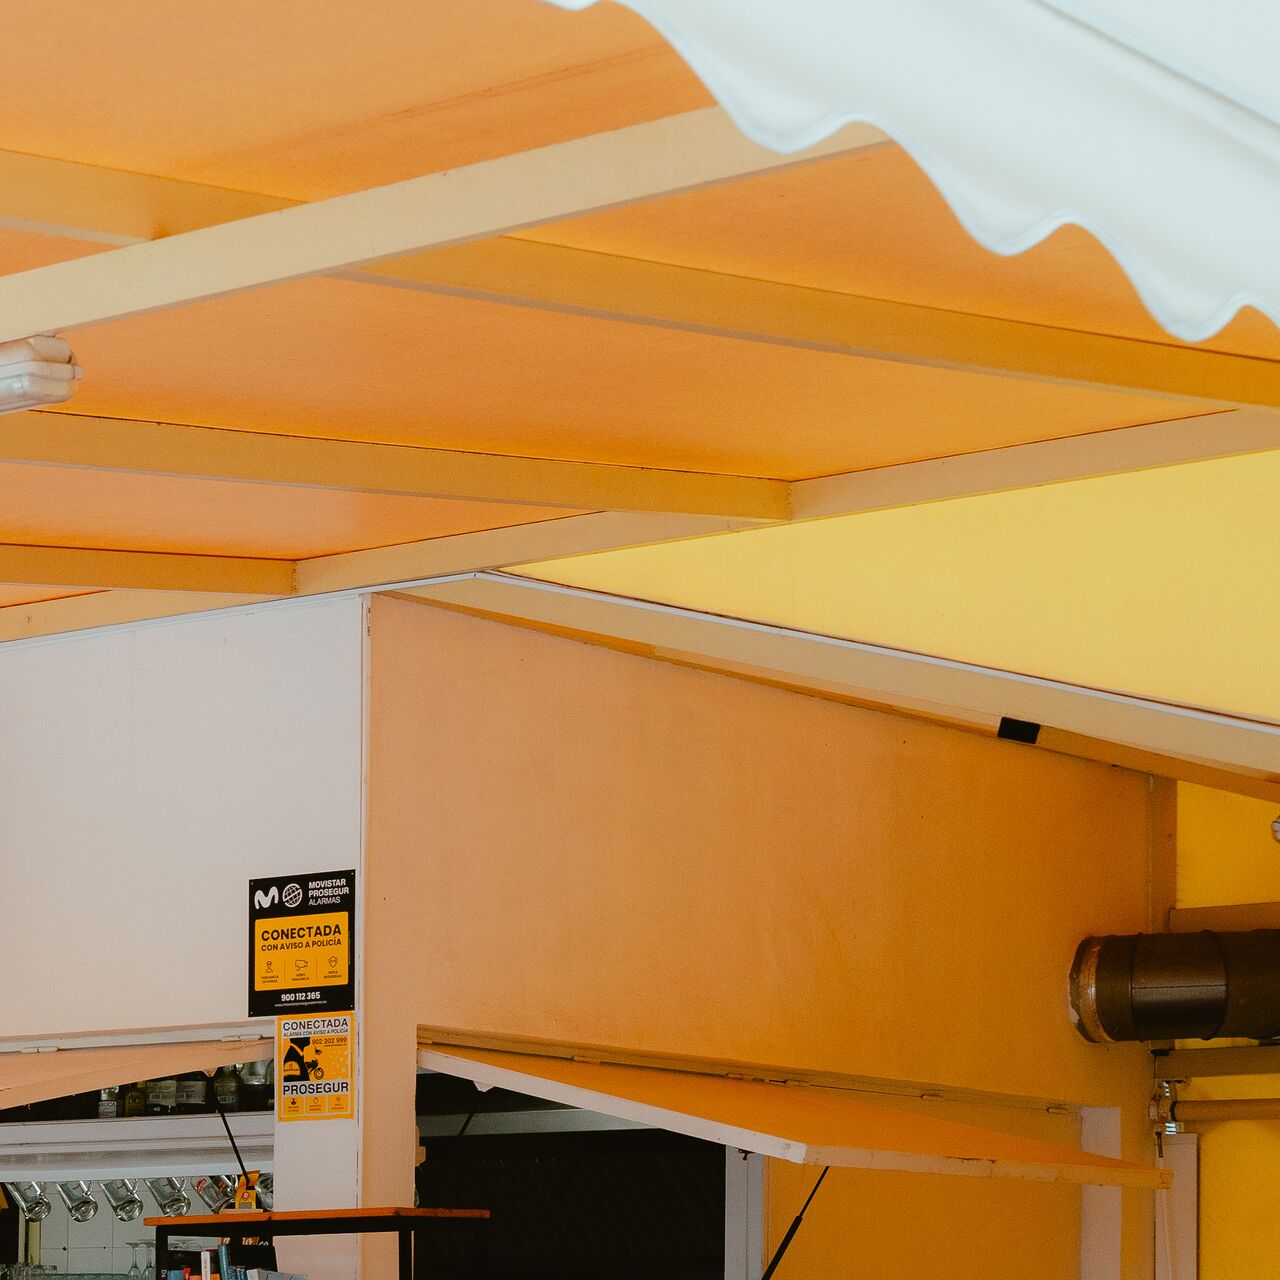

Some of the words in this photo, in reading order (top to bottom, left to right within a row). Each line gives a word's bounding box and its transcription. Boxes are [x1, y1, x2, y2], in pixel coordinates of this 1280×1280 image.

[308, 878, 346, 889] MOVISTAR
[308, 887, 350, 898] PROSEGUR
[308, 896, 341, 906] ALARMAS
[261, 924, 342, 942] CONECTADA
[261, 943, 279, 952] CON
[280, 941, 303, 951] AVISO
[312, 936, 342, 948] POLICÍA
[281, 993, 295, 1002] 900
[296, 992, 306, 1001] 112
[306, 991, 321, 1000] 365
[282, 1018, 349, 1031] CONECTADA
[282, 1081, 349, 1096] PROSEGUR
